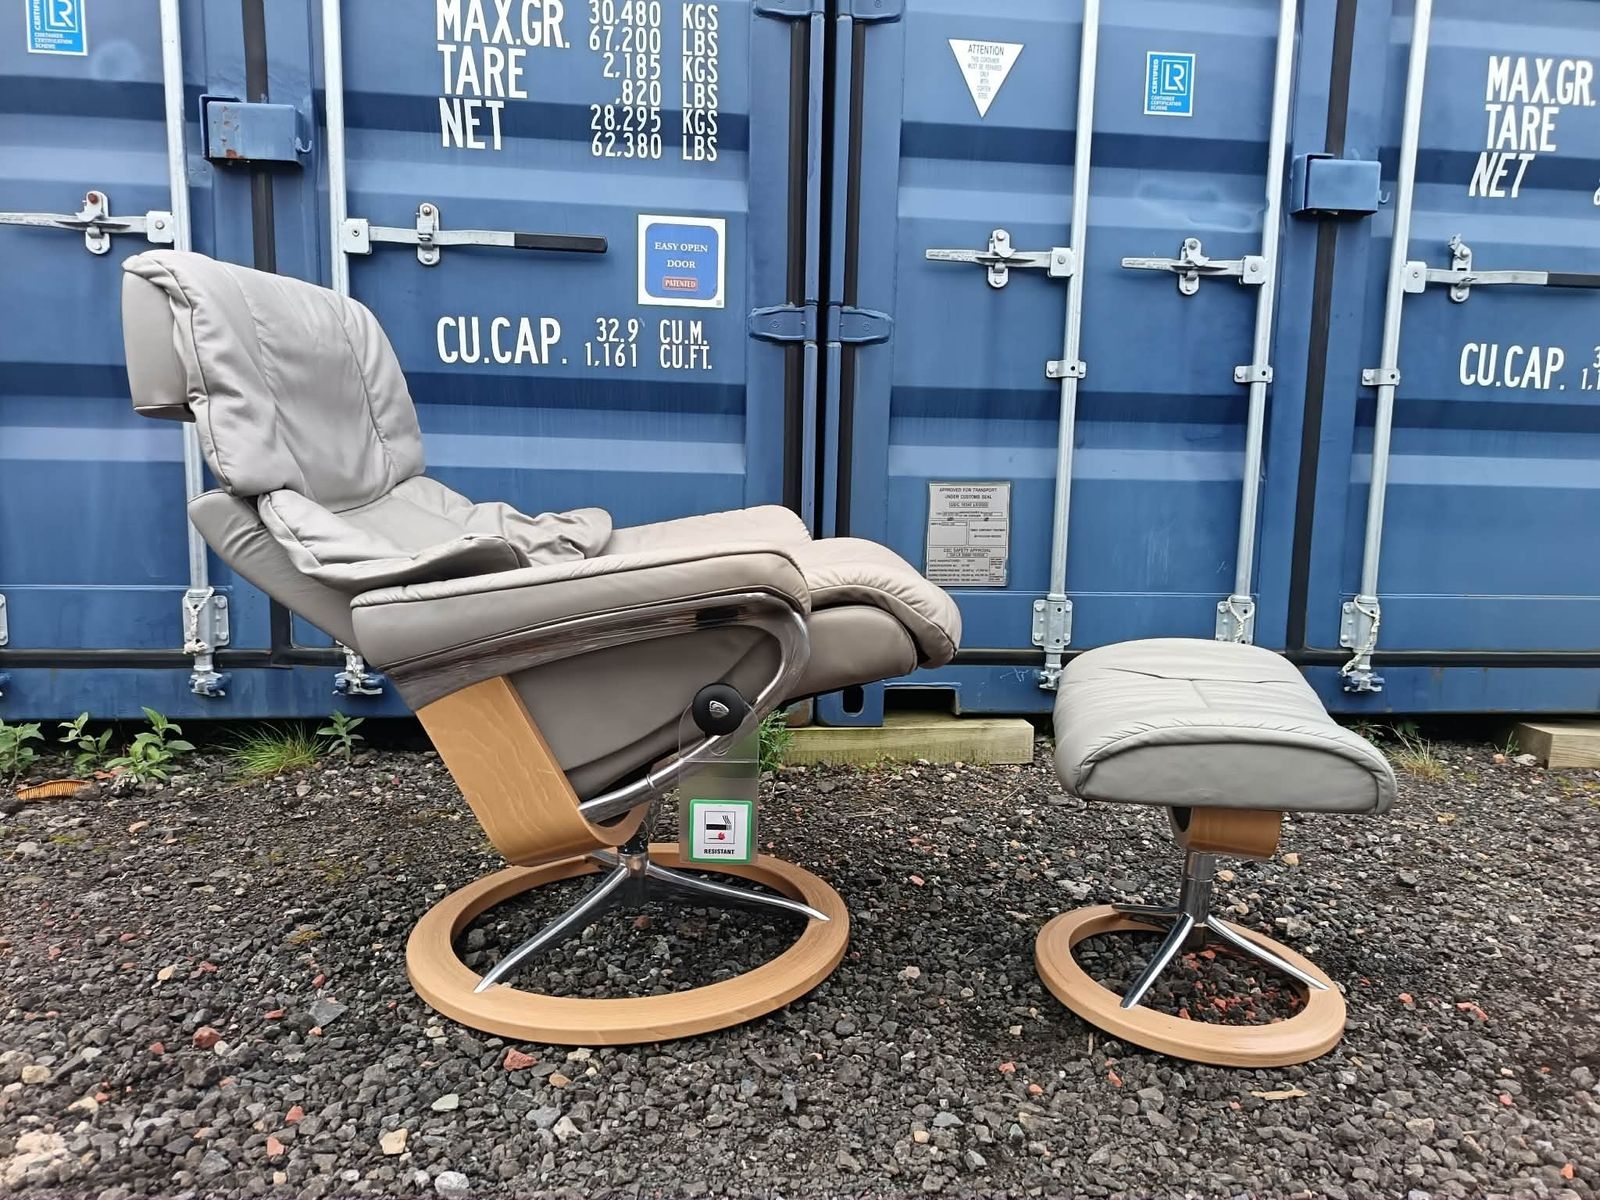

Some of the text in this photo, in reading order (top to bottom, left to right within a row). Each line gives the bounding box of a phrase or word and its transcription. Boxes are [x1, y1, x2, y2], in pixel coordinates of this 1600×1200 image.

[437, 0, 718, 48] MAX.GR. 30,480 KGS
[589, 26, 718, 56] 67,200 LBS
[437, 44, 718, 98] TARE 2,185 KGS
[1165, 64, 1185, 92] LR
[1486, 56, 1596, 106] MAX.GR.
[682, 83, 718, 108] LBS
[439, 98, 718, 150] NET 28,295 KGS
[1485, 104, 1560, 151] TARE
[591, 132, 718, 161] 62,380 LBS
[1469, 152, 1535, 198] NET
[654, 242, 708, 253] EASY OPEN
[667, 260, 696, 269] DOOR
[665, 280, 696, 288] PATENTED
[437, 317, 708, 364] CU.CAP. 32.9 CU.M.
[585, 342, 712, 369] 1,161 CU.FT.
[1460, 342, 1565, 390] CU.CAP.
